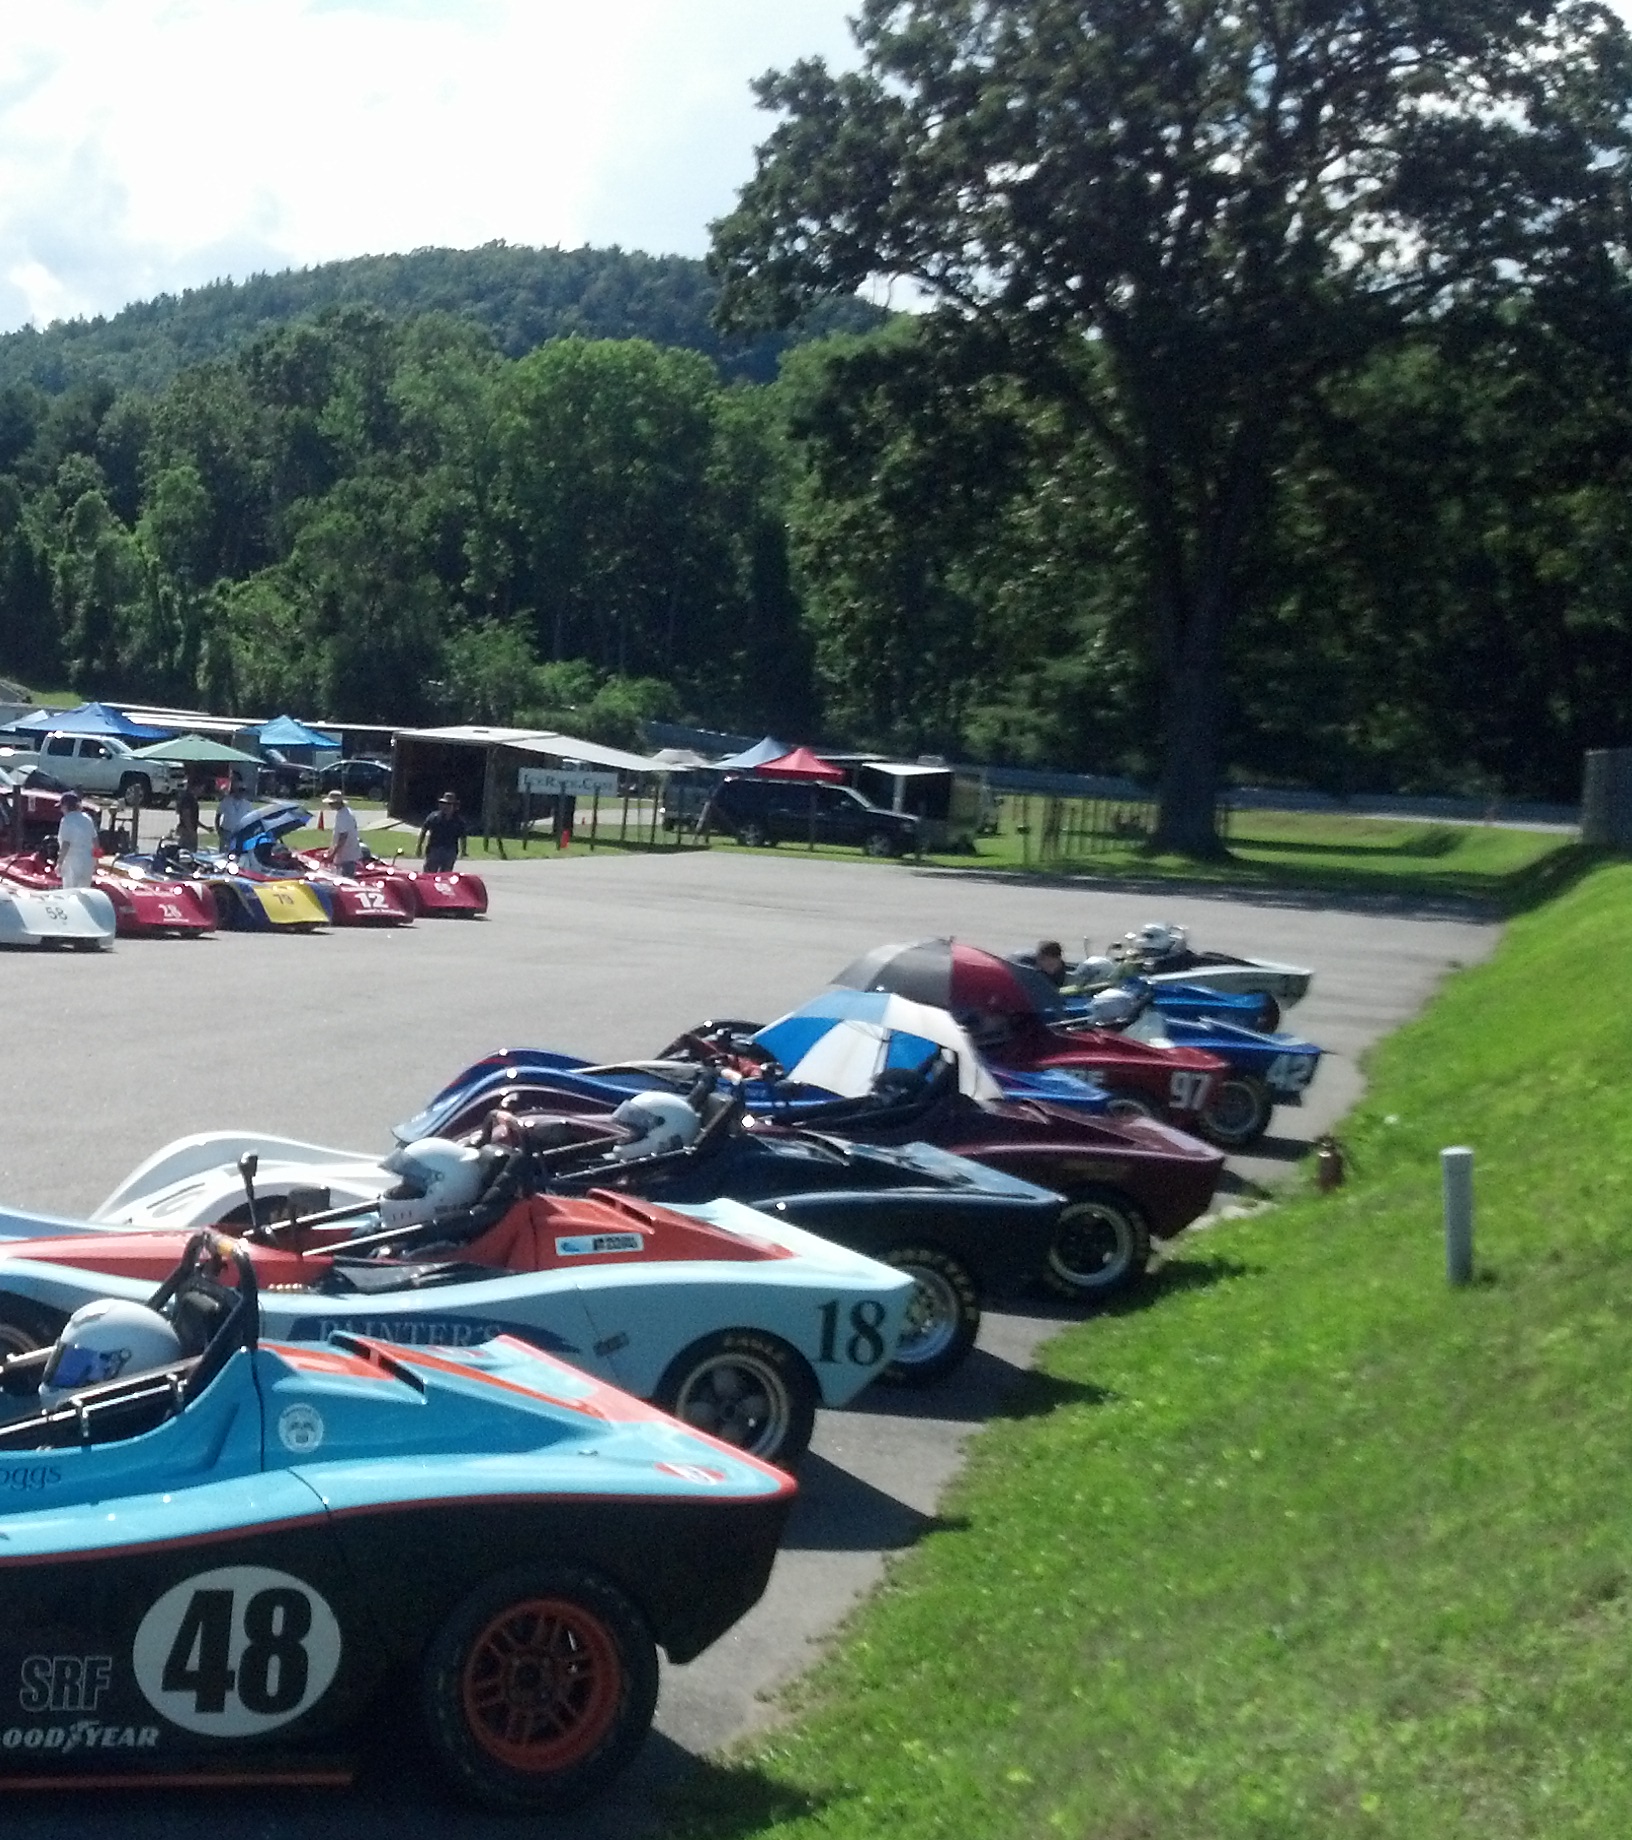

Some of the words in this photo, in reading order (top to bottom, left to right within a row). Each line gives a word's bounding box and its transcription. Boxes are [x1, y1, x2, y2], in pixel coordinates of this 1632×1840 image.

[45, 906, 68, 921] 58
[354, 891, 388, 909] 12
[1168, 1071, 1214, 1111] 97
[1267, 1055, 1315, 1091] 42
[811, 1299, 887, 1366] 18
[161, 1587, 313, 1716] 48
[18, 1654, 113, 1712] SRF
